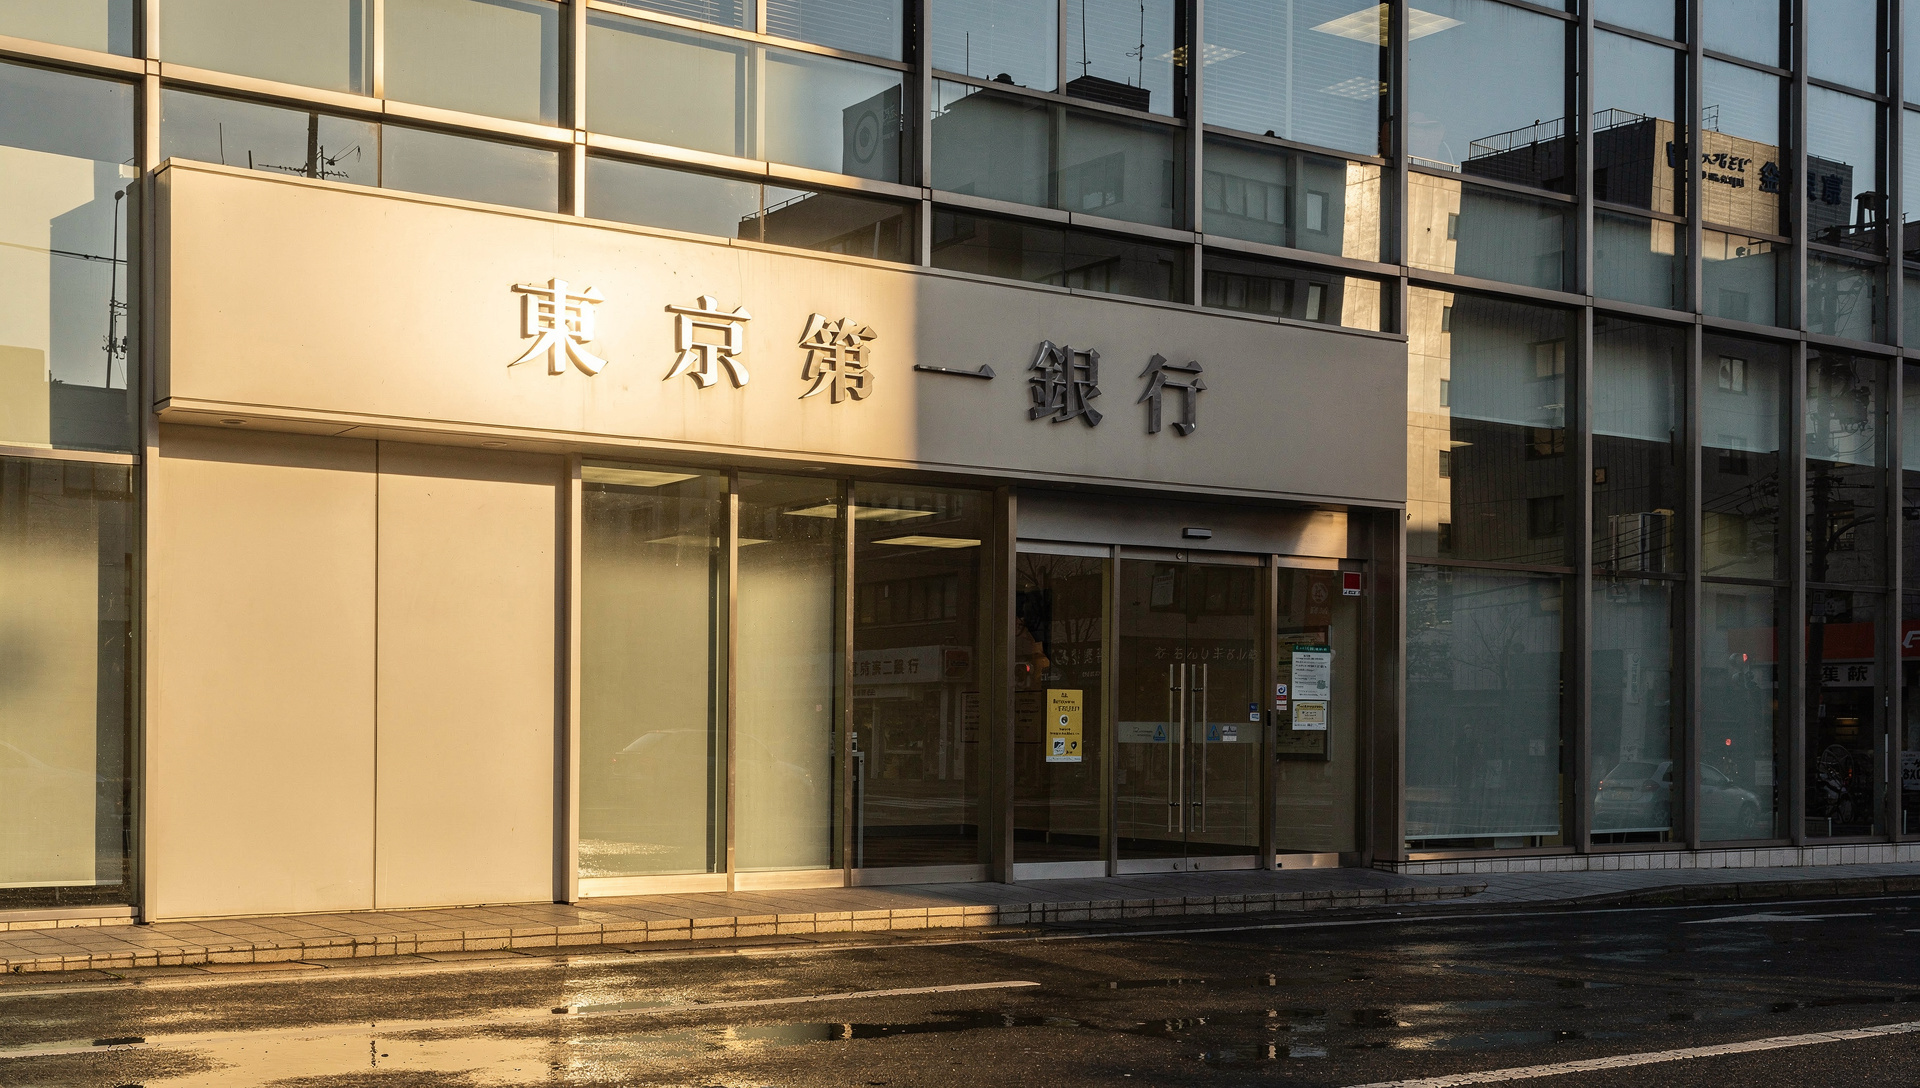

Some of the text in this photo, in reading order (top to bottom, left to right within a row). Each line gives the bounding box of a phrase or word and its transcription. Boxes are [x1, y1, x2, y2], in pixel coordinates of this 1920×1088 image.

[507, 277, 1208, 437] 東京第一銀行
